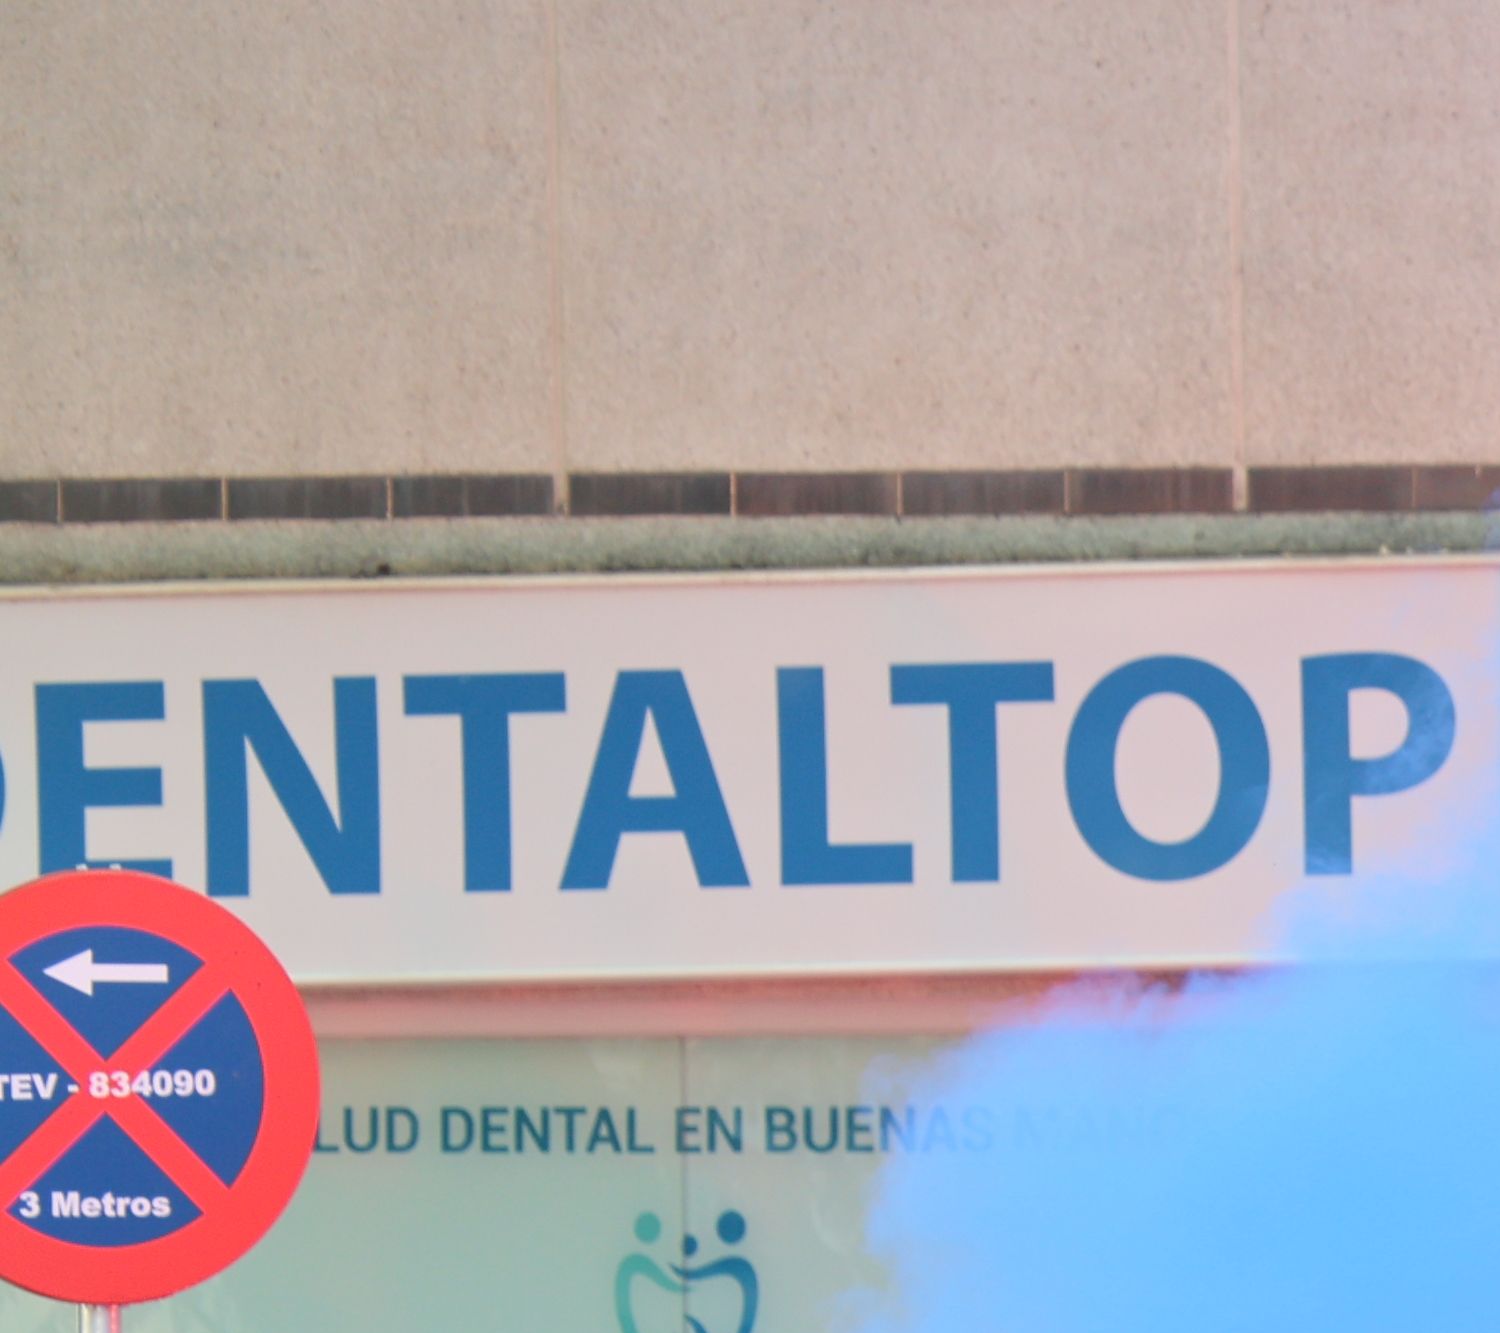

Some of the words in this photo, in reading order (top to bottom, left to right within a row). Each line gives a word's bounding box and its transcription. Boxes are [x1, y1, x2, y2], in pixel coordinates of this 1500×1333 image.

[0, 650, 1458, 897] ENTALTOP
[89, 1069, 216, 1098] 834090
[313, 1106, 419, 1153] LUD
[441, 1106, 655, 1153] DENTAL
[674, 1106, 744, 1153] EN
[764, 1105, 994, 1153] BUENAS
[19, 1191, 41, 1218] 3
[51, 1191, 171, 1218] Metros
